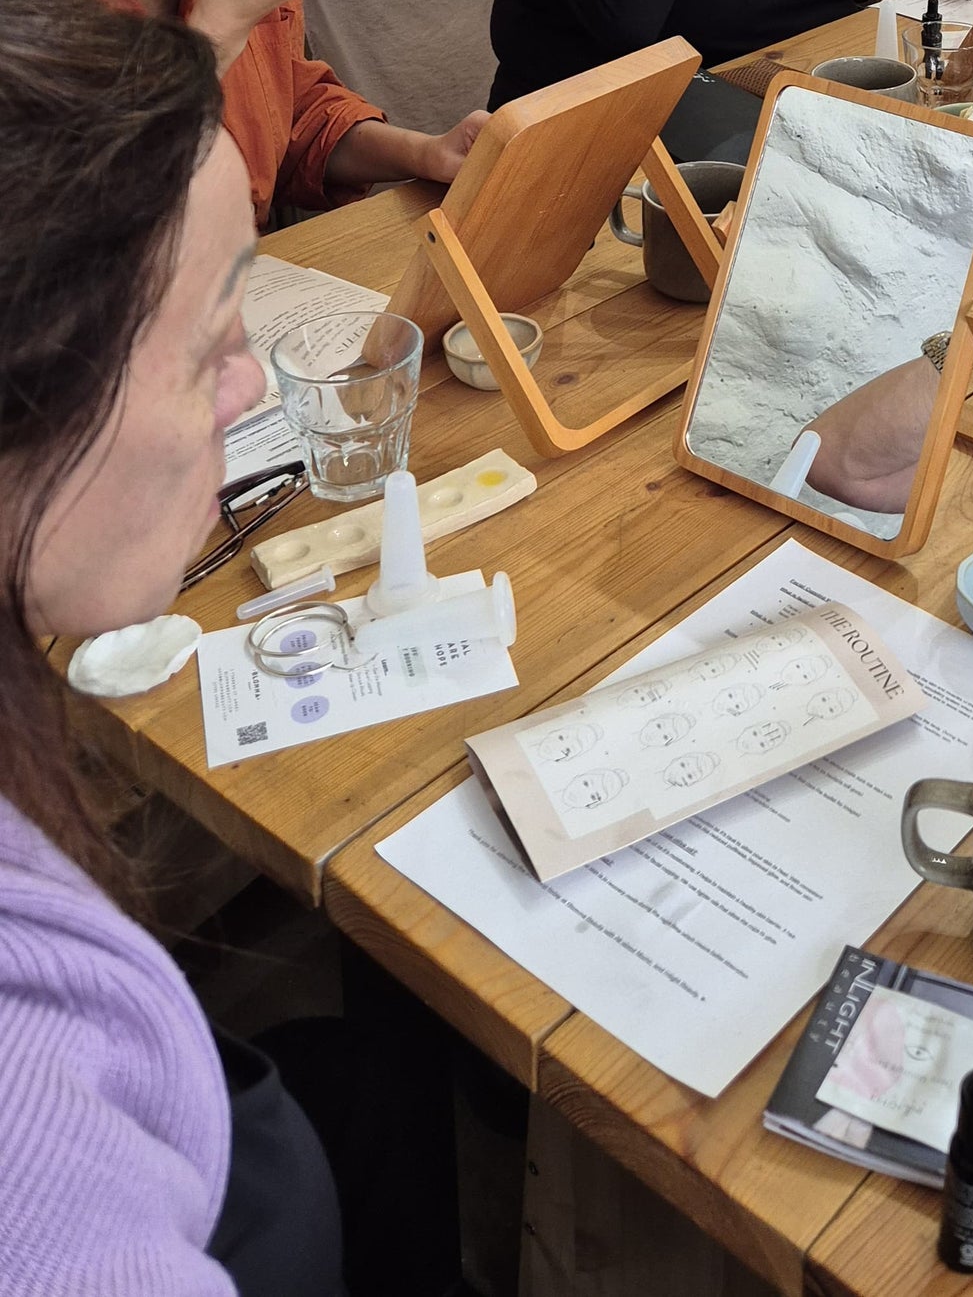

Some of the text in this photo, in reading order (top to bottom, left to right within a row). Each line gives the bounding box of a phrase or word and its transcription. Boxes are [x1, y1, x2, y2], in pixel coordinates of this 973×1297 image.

[434, 644, 447, 667] HOPS
[447, 643, 459, 660] ARE
[460, 640, 471, 656] IAL
[820, 610, 849, 633] THE
[842, 629, 904, 700] ROUTINE
[824, 957, 877, 1055] INLIGHT
